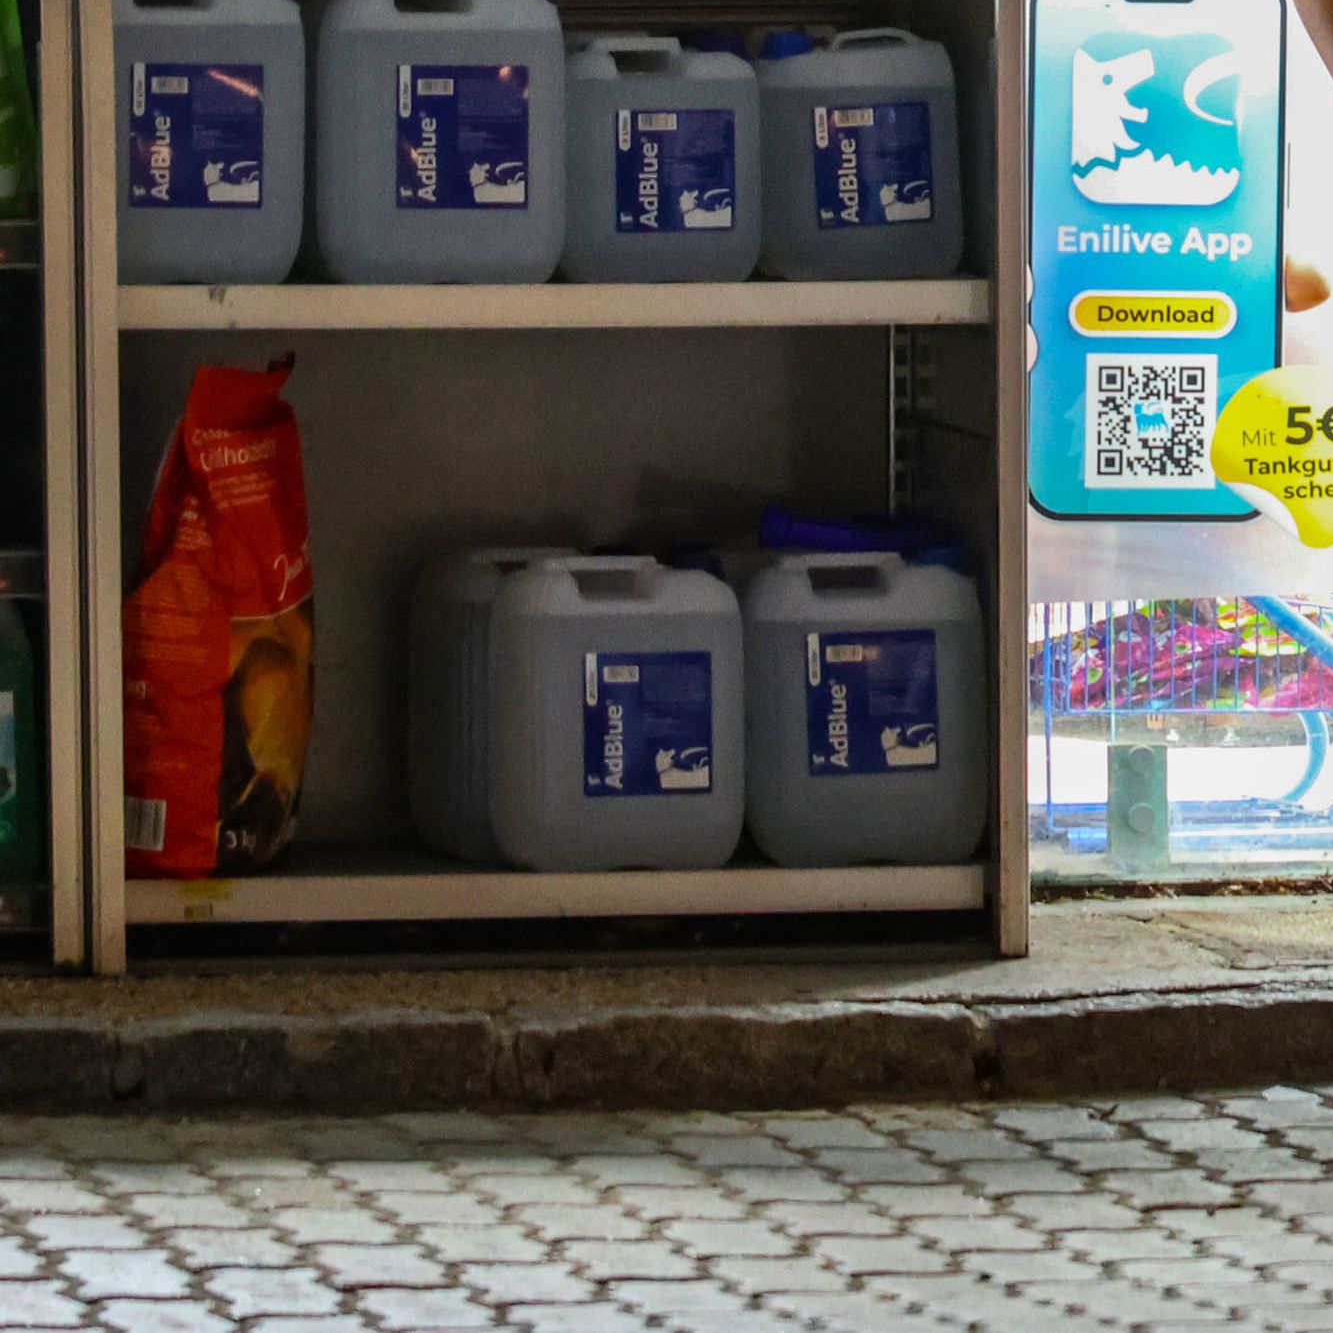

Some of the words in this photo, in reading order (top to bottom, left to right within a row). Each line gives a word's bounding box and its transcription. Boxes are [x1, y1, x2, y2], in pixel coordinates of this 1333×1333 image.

[150, 115, 172, 202] AdBlue
[416, 116, 437, 203] AdBlue
[639, 142, 659, 228] AdBlue
[838, 137, 860, 224] AdBlue
[1056, 225, 1173, 254] Enilive
[1180, 227, 1253, 261] App
[1097, 305, 1215, 323] Download
[1242, 429, 1276, 447] Mit
[604, 704, 624, 790] AdBlue
